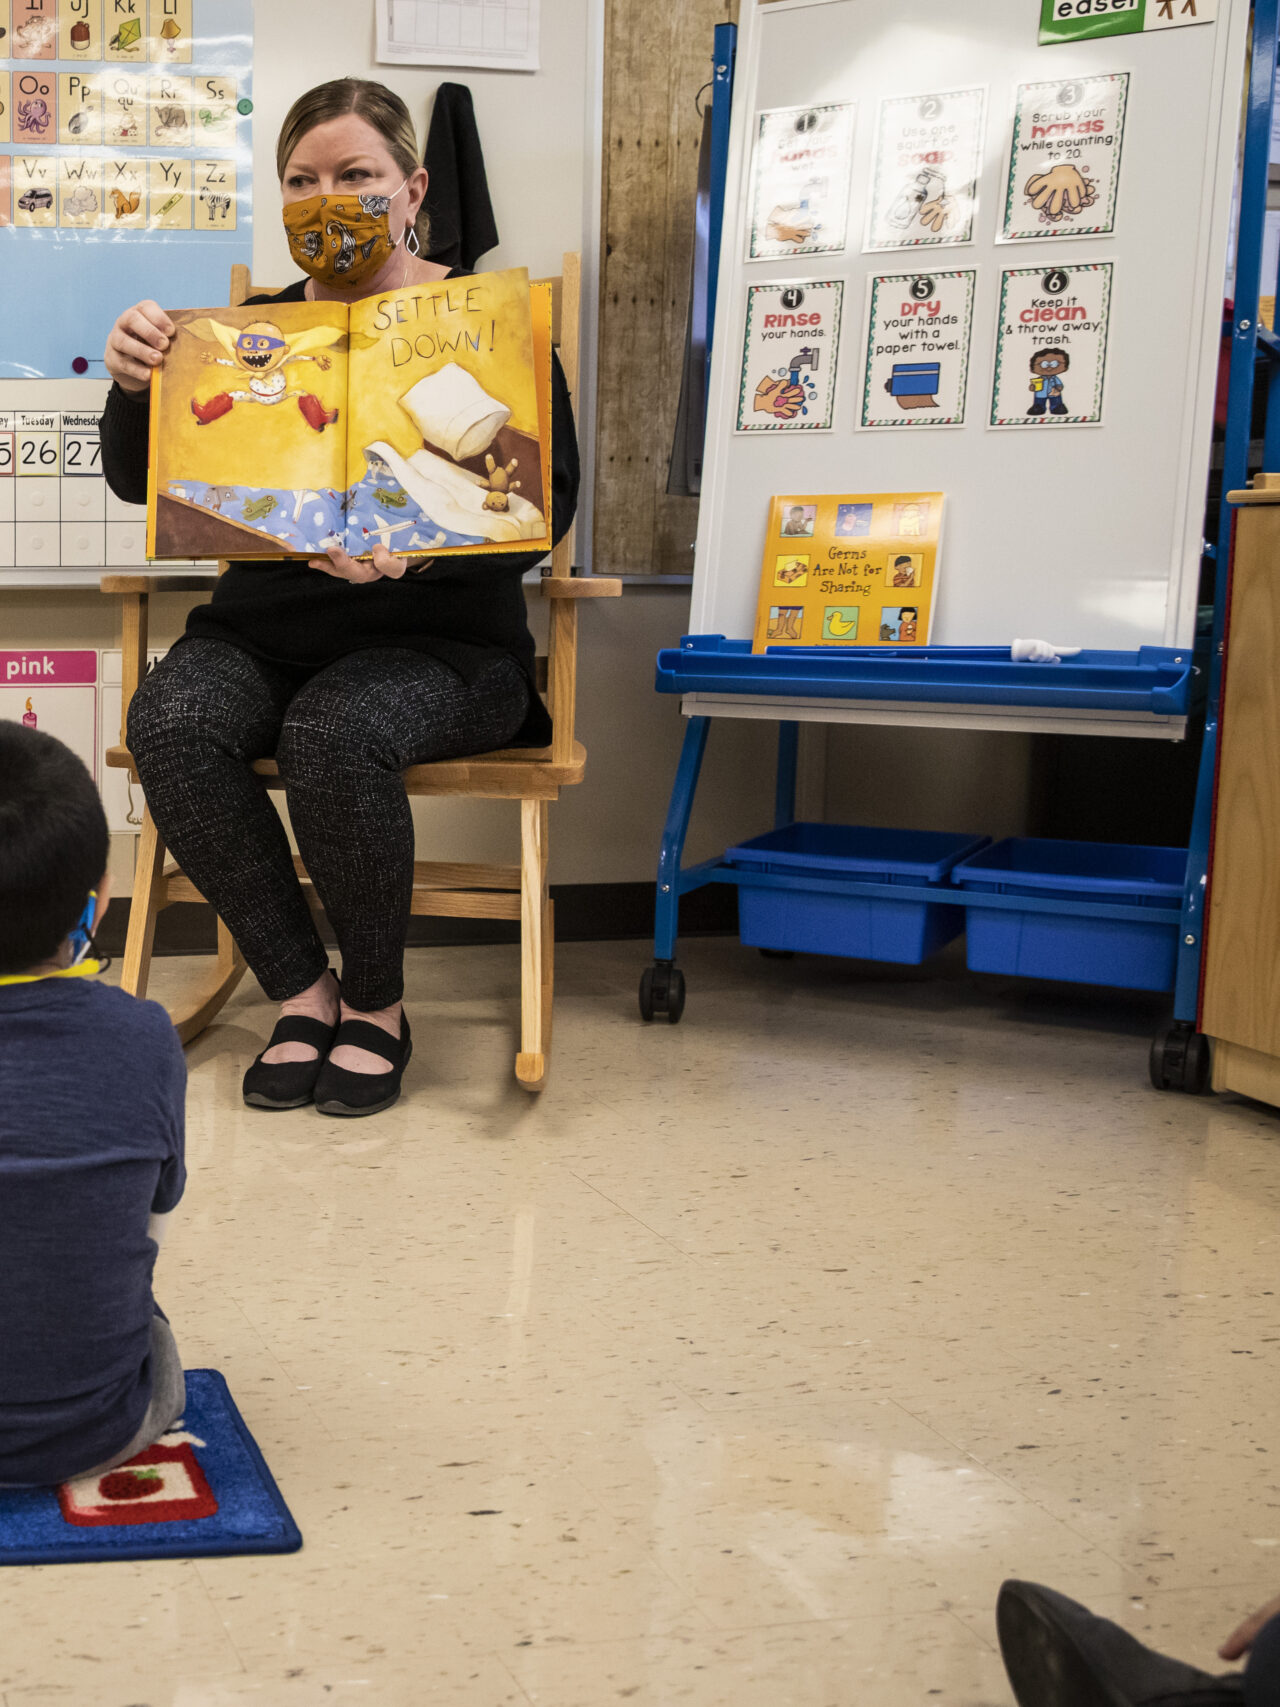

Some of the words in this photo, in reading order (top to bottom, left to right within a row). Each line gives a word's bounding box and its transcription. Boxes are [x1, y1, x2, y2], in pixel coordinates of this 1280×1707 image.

[19, 75, 50, 95] Oo
[69, 76, 91, 102] Pp
[160, 79, 178, 99] Rr
[206, 81, 225, 100] Ss
[1032, 111, 1071, 123] Scrub
[1076, 108, 1107, 121] your
[1031, 120, 1104, 138] hands
[1020, 140, 1053, 151] while
[1056, 135, 1113, 147] counting
[1048, 151, 1061, 160] to
[22, 159, 48, 179] Vv
[64, 161, 98, 181] Ww
[114, 161, 138, 182] Xx
[160, 163, 182, 188] Yy
[206, 163, 226, 183] Zz
[372, 286, 483, 331] SETTLE
[900, 300, 942, 318] Dry
[1031, 298, 1063, 309] Keep
[1066, 296, 1078, 307] it
[764, 312, 822, 329] Rinse
[883, 319, 913, 331] your
[917, 314, 958, 327] hands
[1020, 306, 1087, 323] clean
[761, 329, 786, 341] your
[790, 328, 826, 339] hands.
[899, 329, 928, 341] with
[931, 330, 940, 339] a
[1005, 325, 1013, 334] &
[1018, 323, 1058, 334] throw
[1062, 321, 1101, 333] away
[391, 319, 496, 368] DOWN!
[876, 343, 917, 356] paper
[921, 340, 960, 352] towel.
[1032, 335, 1072, 345] trash.
[21, 415, 54, 428] Tuesday
[62, 416, 100, 426] Wednesda
[21, 440, 58, 464] 26
[66, 440, 102, 466] 27
[828, 546, 867, 560] Germs
[812, 563, 835, 577] Are
[837, 561, 859, 576] Not
[863, 564, 883, 577] for
[819, 580, 872, 596] Sharing
[6, 656, 56, 680] pink
